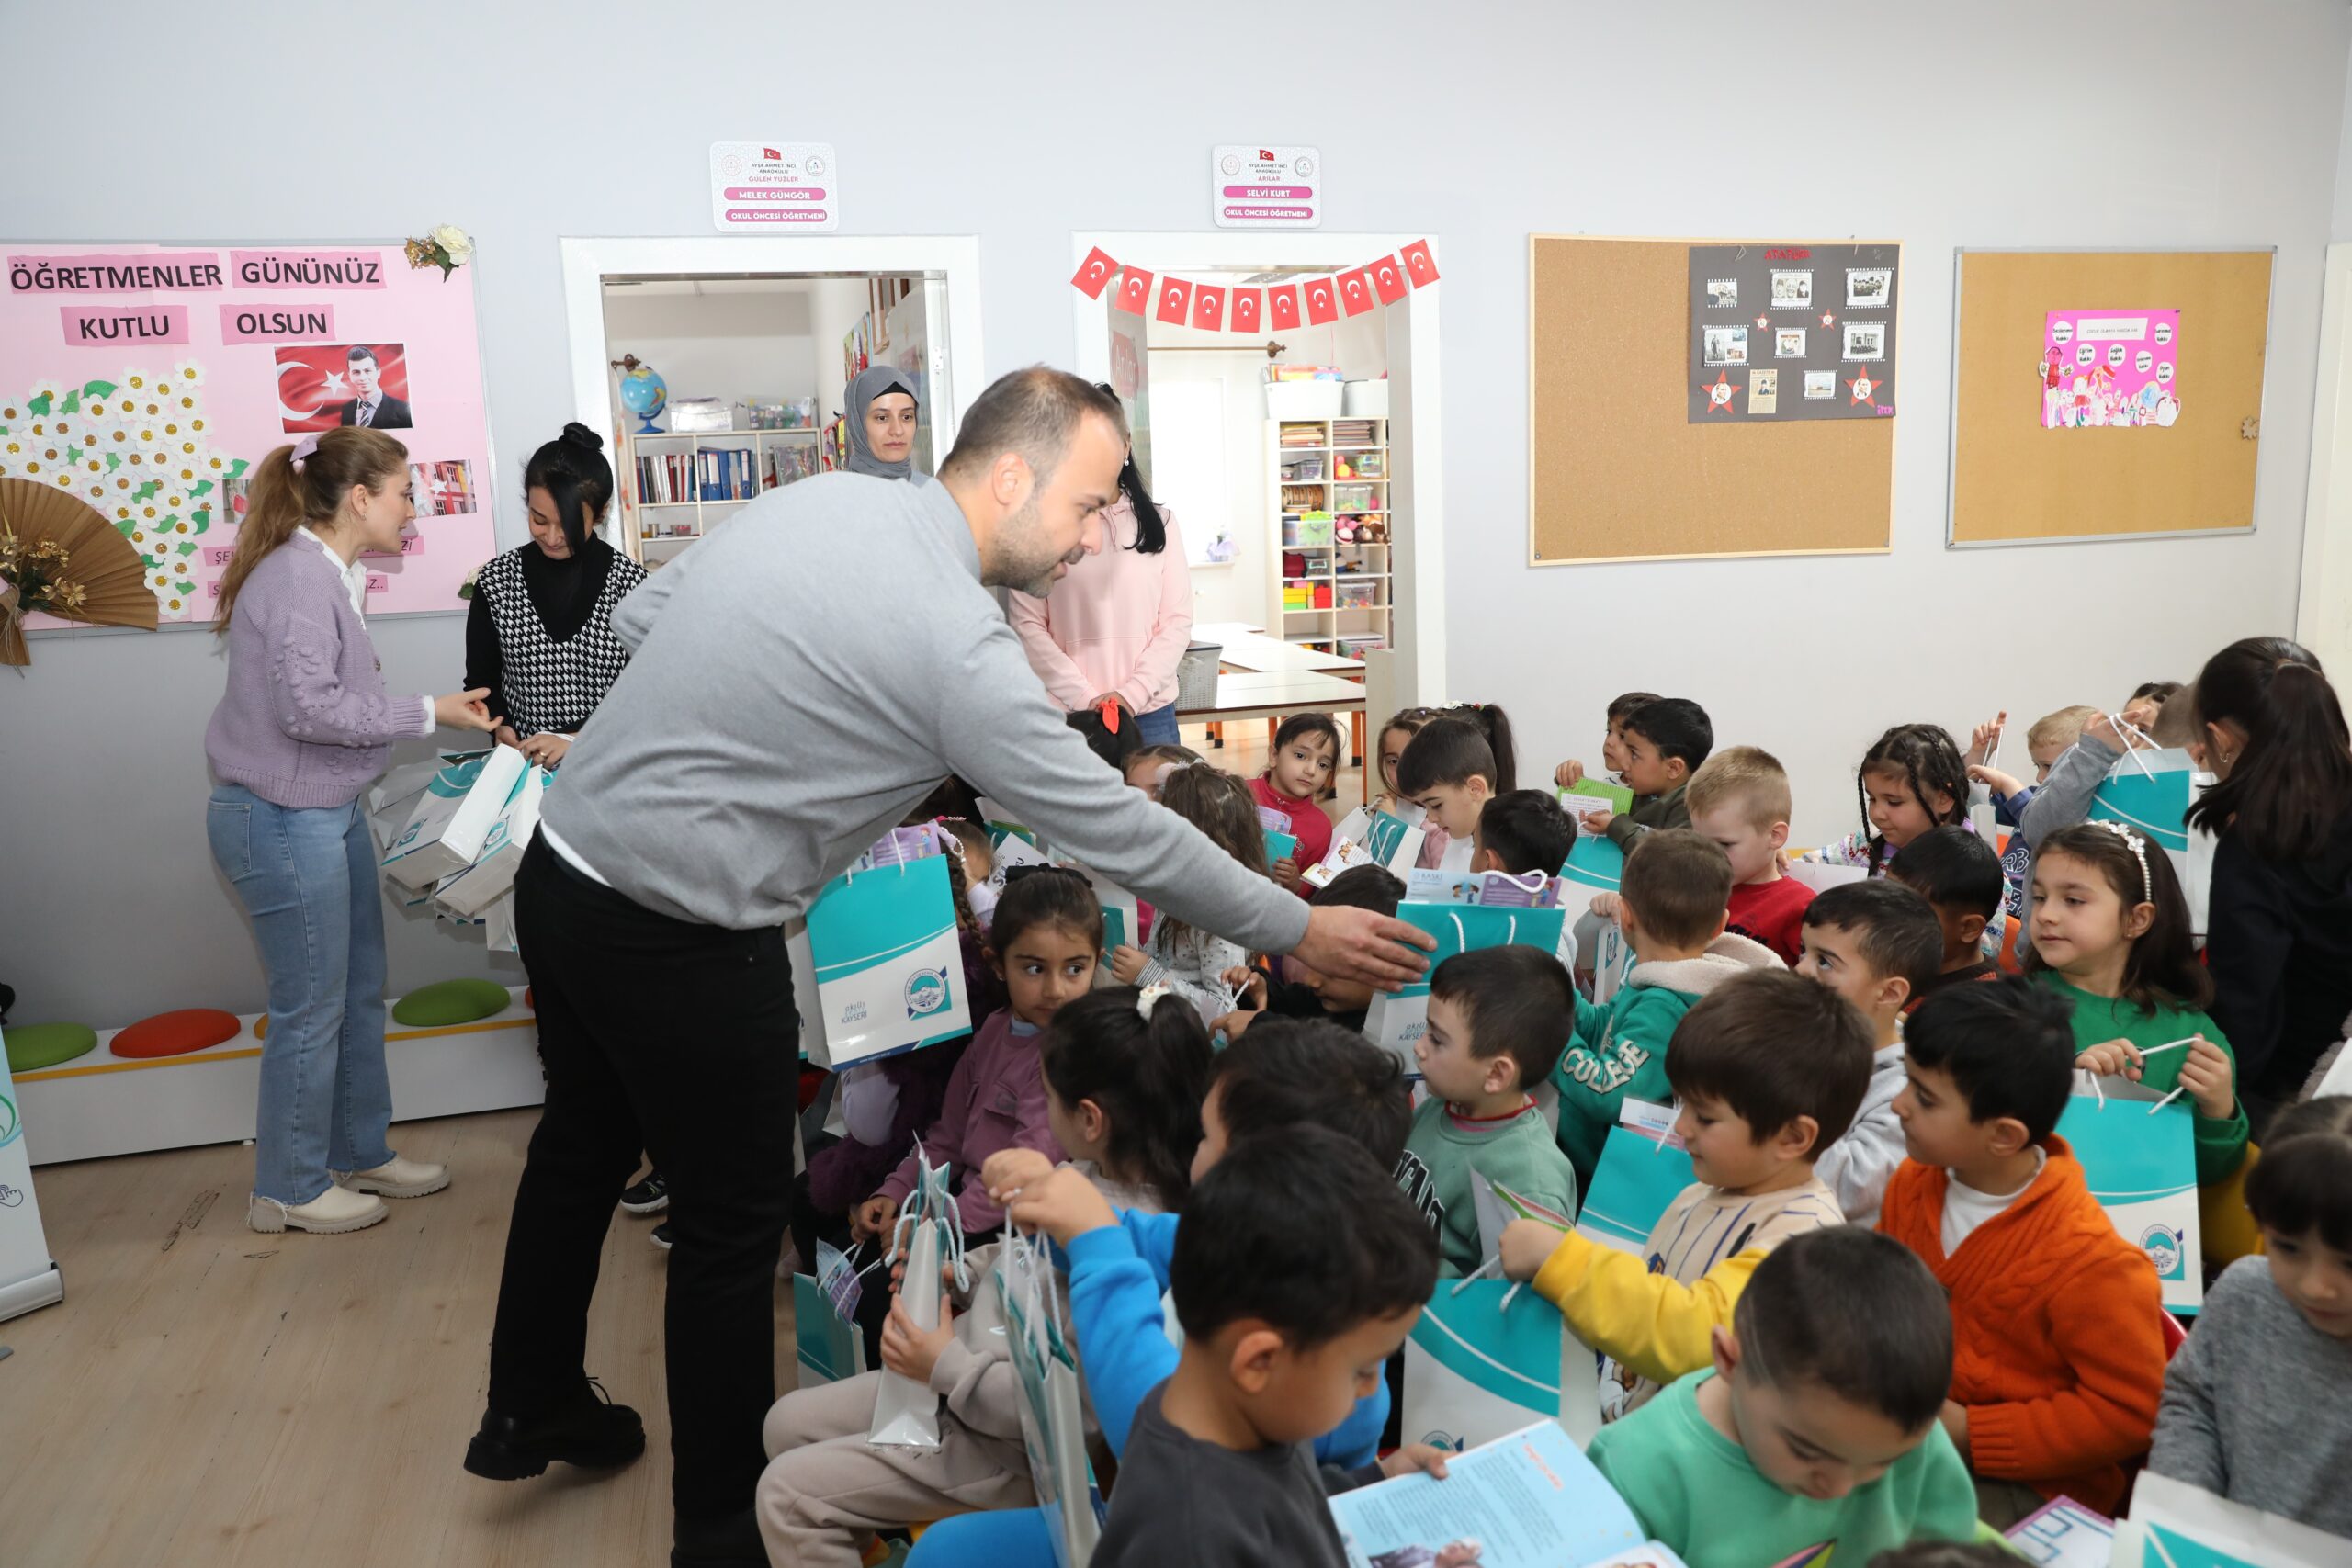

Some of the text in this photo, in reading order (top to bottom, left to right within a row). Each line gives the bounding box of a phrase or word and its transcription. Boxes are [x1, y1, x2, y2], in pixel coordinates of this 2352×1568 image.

[739, 190, 811, 200] MELEK GÜNGÖR
[1247, 188, 1291, 197] SELVİ KURT
[754, 210, 781, 220] ÖNCESİ
[782, 210, 825, 220] ÖĞRETMENİ
[1244, 209, 1269, 217] ÖNCESİ
[10, 257, 380, 290] ÖĞRETMENLER GÜNÜNÜZ
[79, 312, 327, 339] KUTLU OLSUN
[1562, 1040, 1650, 1094] COLLEGE
